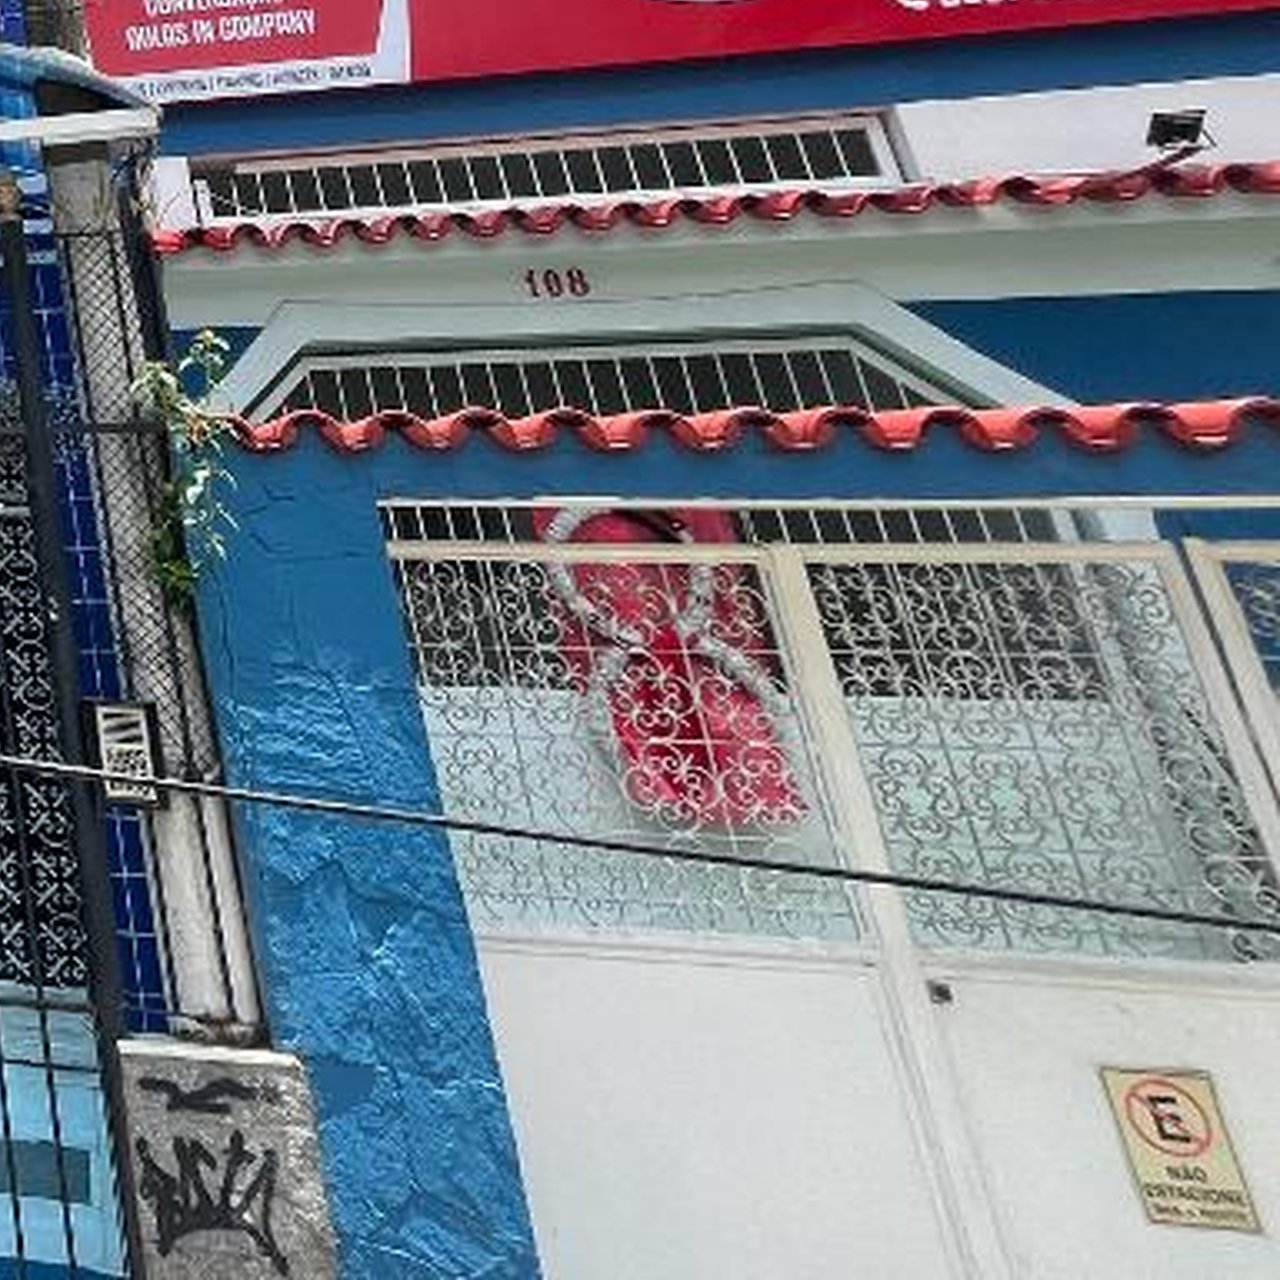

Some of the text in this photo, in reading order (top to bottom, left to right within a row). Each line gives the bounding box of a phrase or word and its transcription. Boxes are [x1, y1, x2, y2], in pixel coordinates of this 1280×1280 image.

[191, 18, 216, 44] IN
[218, 9, 315, 41] COMPANY
[524, 268, 591, 298] 108
